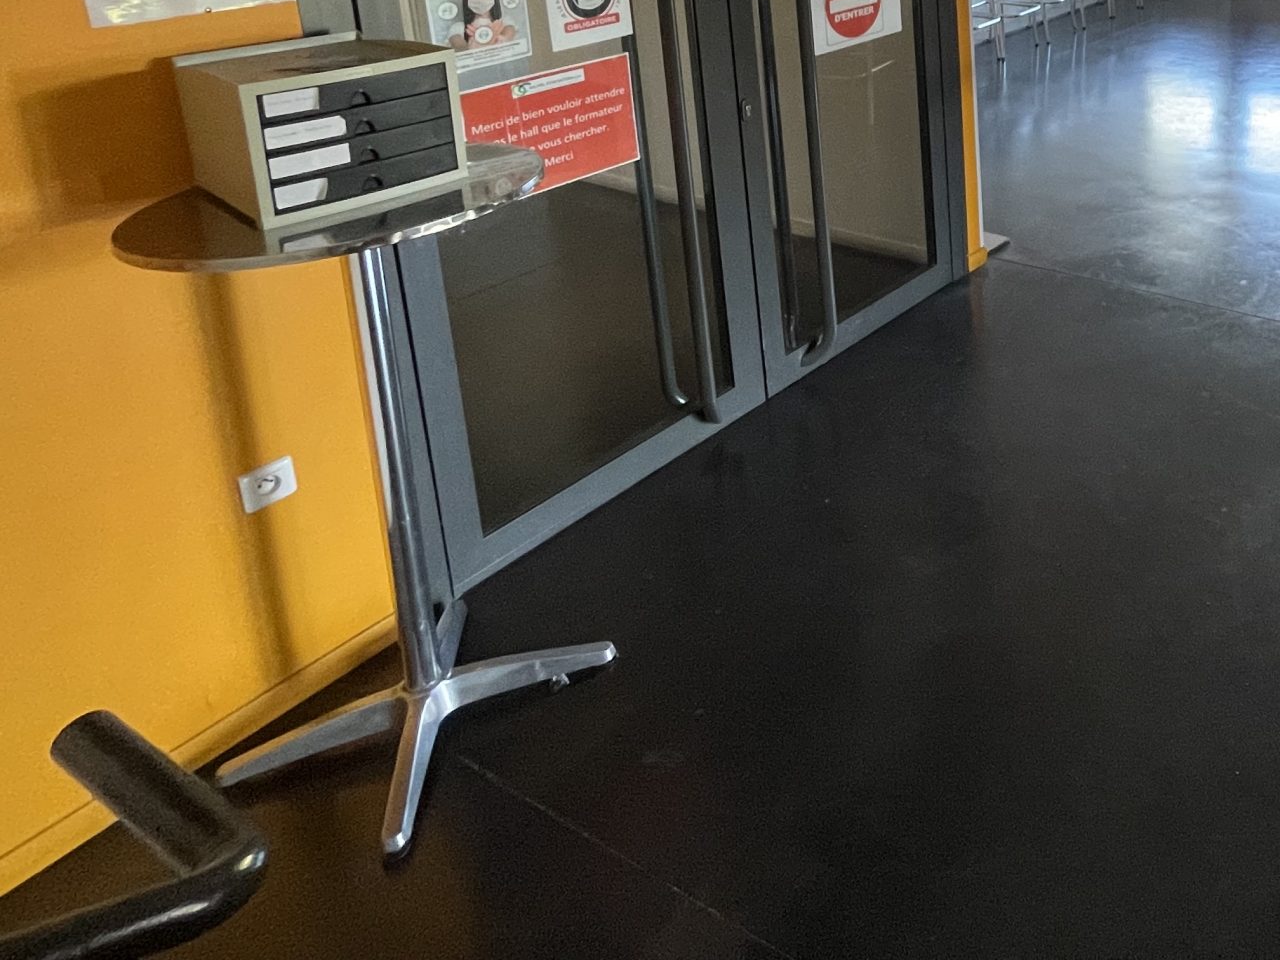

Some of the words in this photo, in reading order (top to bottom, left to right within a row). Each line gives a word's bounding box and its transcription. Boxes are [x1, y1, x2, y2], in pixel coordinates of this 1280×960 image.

[566, 15, 617, 31] OBLIGATOIRE
[834, 6, 875, 23] D'ENTRER
[471, 118, 504, 135] Merci
[506, 113, 520, 126] de
[522, 108, 545, 122] bien
[547, 98, 583, 114] vouloir
[585, 87, 625, 104] attendre
[509, 132, 518, 143] le
[520, 124, 539, 140] hall
[541, 122, 561, 138] que
[563, 117, 573, 127] le
[575, 103, 623, 123] formateur
[537, 139, 562, 151] vous
[564, 124, 610, 144] chercher.
[545, 150, 574, 167] Merci
